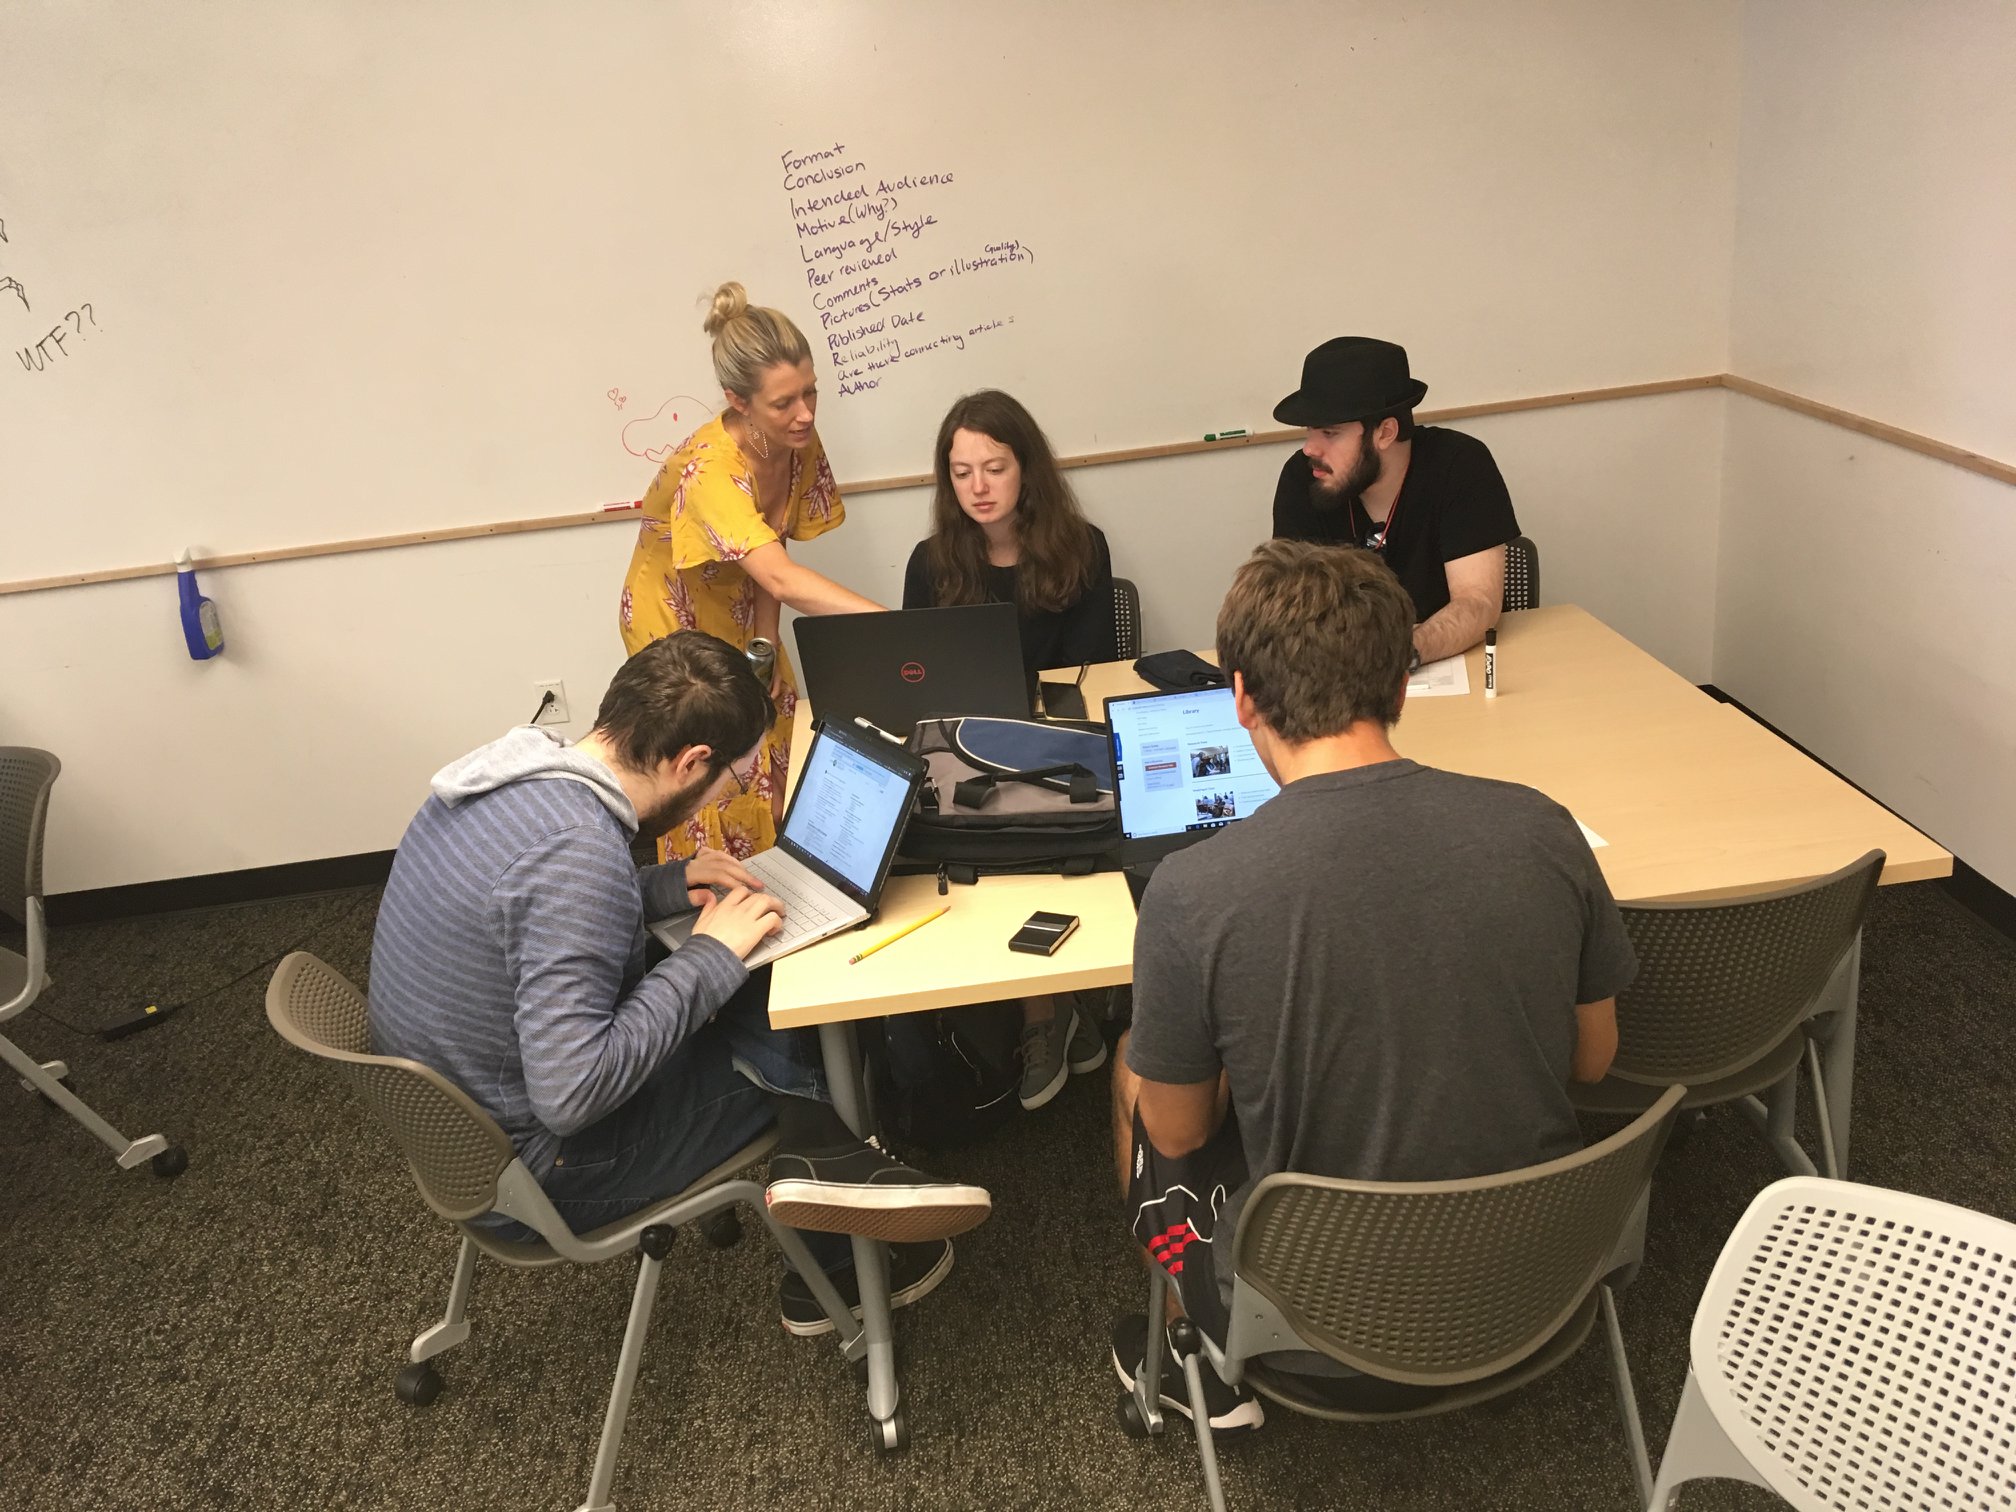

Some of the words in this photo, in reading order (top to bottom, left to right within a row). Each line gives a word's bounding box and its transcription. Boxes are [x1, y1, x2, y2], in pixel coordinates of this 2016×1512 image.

[781, 142, 845, 174] Format
[783, 161, 866, 191] Conclusion
[790, 187, 870, 219] Intended
[875, 172, 955, 196] Audience
[806, 268, 834, 288] Peer
[928, 268, 947, 282] or
[813, 276, 879, 310] Comments
[15, 303, 104, 372] WTF??
[827, 316, 886, 351] Published
[890, 311, 926, 329] Date
[832, 338, 901, 367] Reliability
[838, 377, 882, 398] Author
[902, 668, 923, 676] DELL
[1182, 708, 1200, 716] Library
